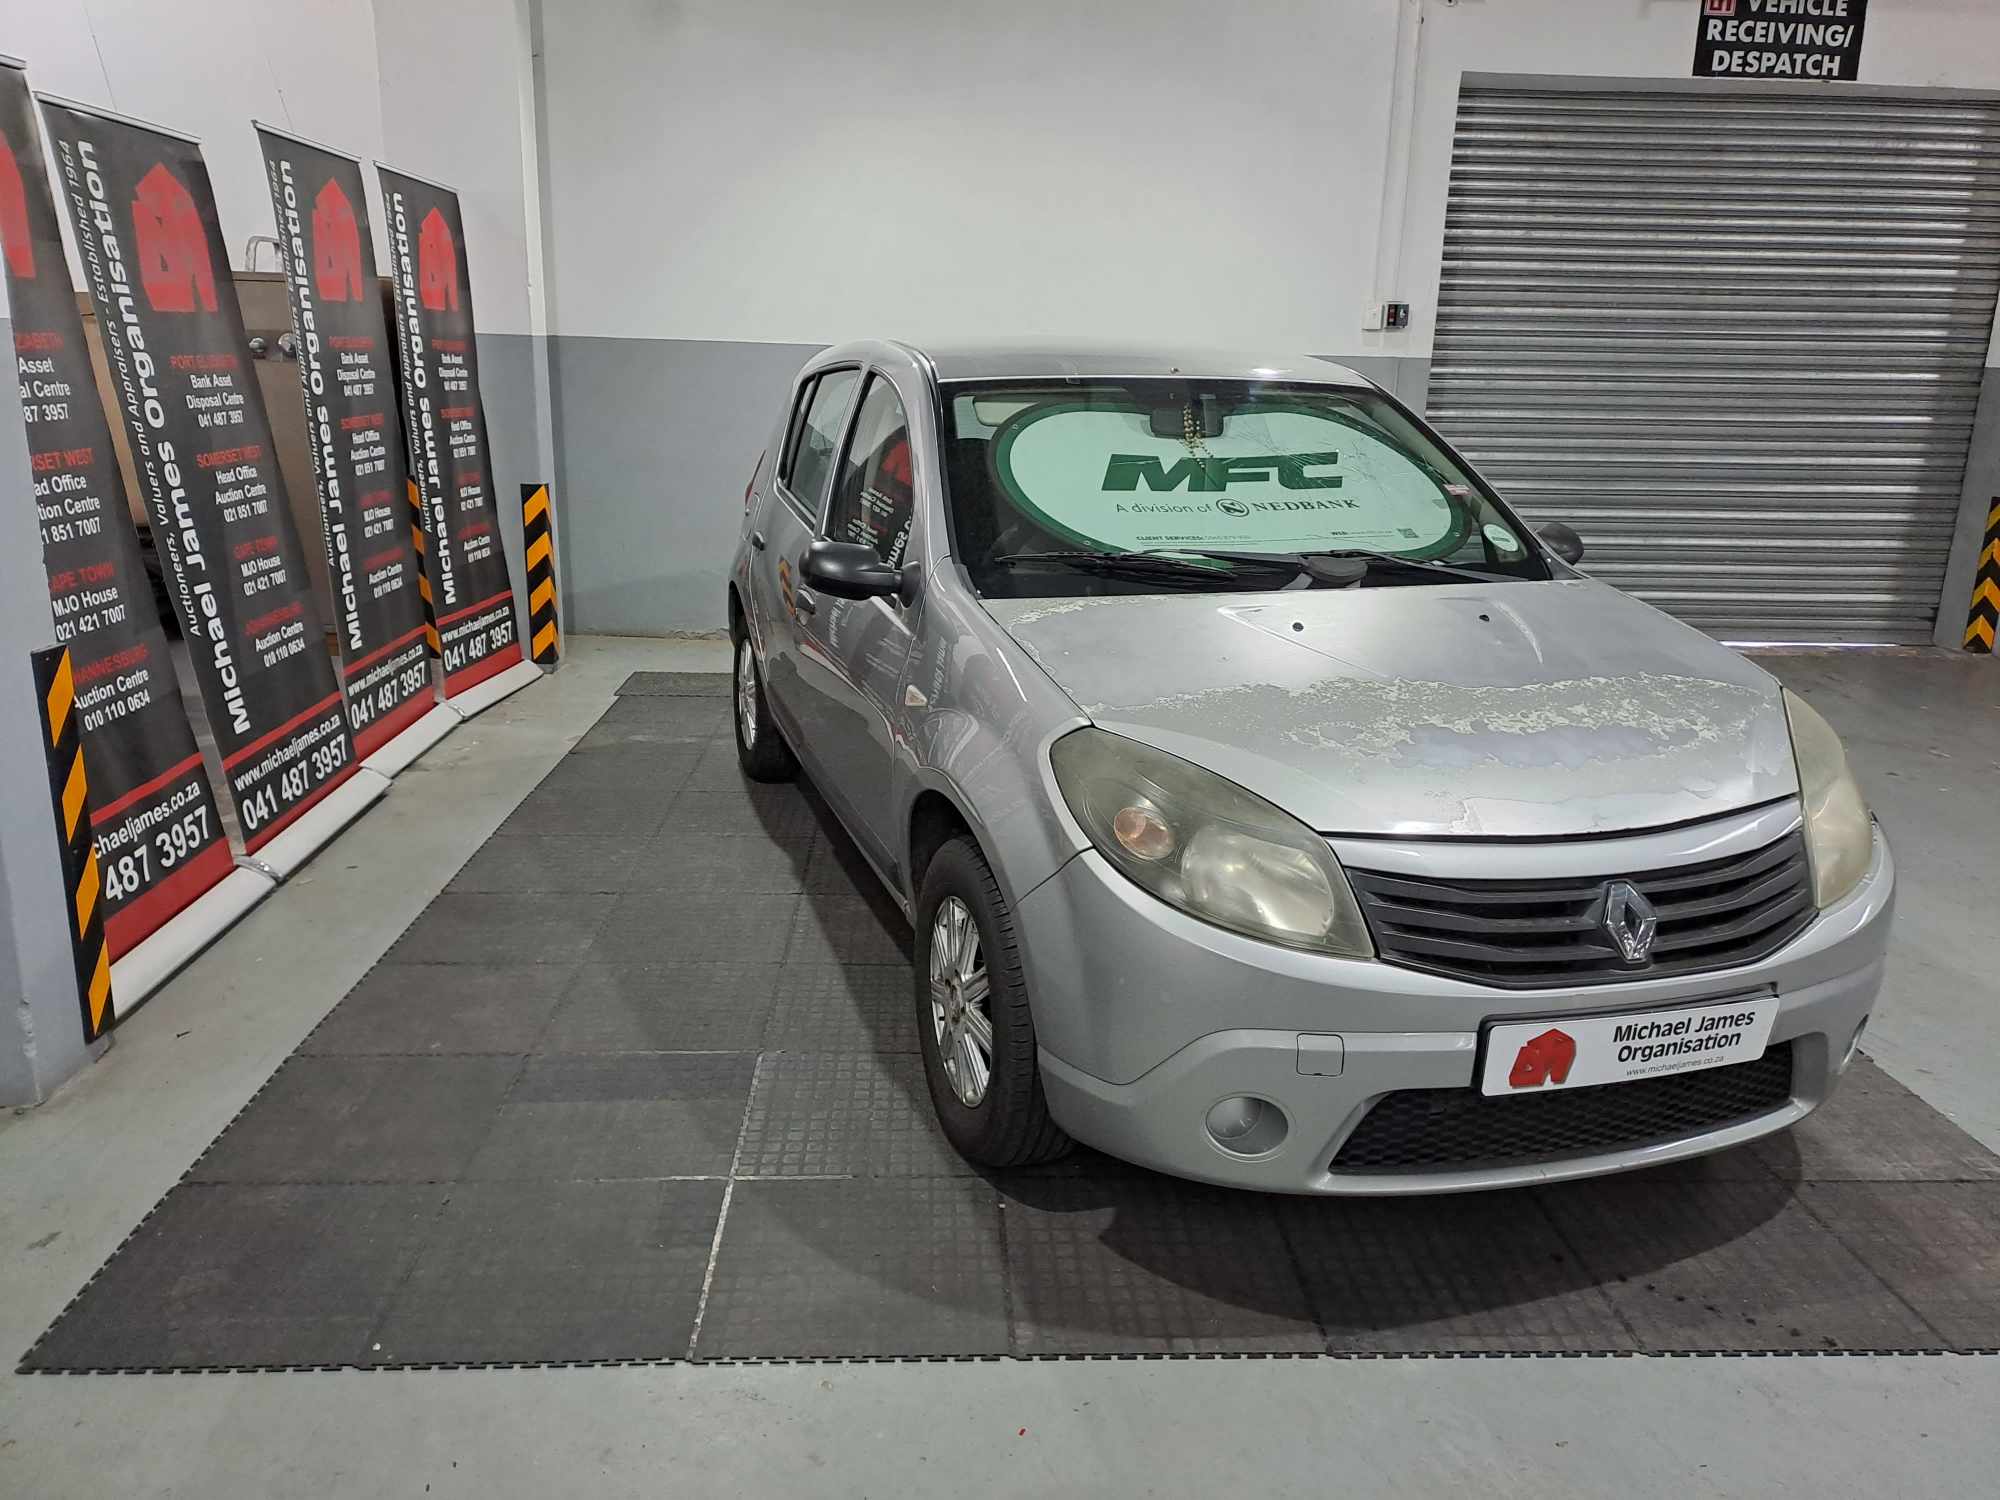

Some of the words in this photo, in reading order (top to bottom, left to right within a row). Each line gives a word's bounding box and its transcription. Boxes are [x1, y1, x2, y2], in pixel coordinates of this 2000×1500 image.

[1750, 0, 1848, 17] VEHICLE
[1706, 19, 1855, 48] RECEIVING/
[1711, 50, 1841, 77] DESPATCH
[58, 139, 81, 188] 1964
[71, 193, 110, 304] Established
[77, 140, 166, 429] Organisation
[279, 160, 325, 395] Organisation
[392, 192, 426, 389] Organisation
[19, 357, 54, 373] Asset
[106, 319, 142, 417] Appraisers
[190, 374, 213, 389] Bank
[33, 380, 71, 397] Centre
[185, 395, 221, 411] Disposal
[222, 392, 245, 405] Centre
[42, 403, 69, 421] 3957
[198, 414, 212, 428] 041
[213, 411, 227, 426] 487
[228, 410, 244, 423] 3957
[131, 420, 151, 456] and
[420, 397, 441, 490] James
[215, 468, 235, 485] Head
[236, 465, 258, 480] Office
[316, 405, 343, 515] James
[1101, 451, 1343, 492] MFC
[51, 475, 87, 493] Office
[145, 461, 170, 526] Valuers
[215, 487, 245, 505] Auction
[244, 484, 267, 498] Centre
[64, 497, 101, 515] Centre
[157, 440, 206, 571] James
[223, 507, 238, 523] 021
[238, 503, 252, 519] 851
[251, 500, 268, 515] 7007
[1116, 503, 1129, 513] A
[1131, 503, 1194, 513] division
[1199, 501, 1214, 512] of
[1255, 499, 1361, 512] NEDBANK
[51, 523, 75, 542] 851
[75, 517, 101, 537] 7007
[430, 496, 457, 605] Michael
[53, 594, 80, 617] MJO
[81, 587, 118, 608] House
[165, 532, 202, 637] Auctioneers,
[332, 523, 363, 650] Michael
[56, 621, 77, 641] 021
[79, 613, 100, 633] 421
[101, 605, 126, 626] 7007
[441, 606, 510, 643] www.michaeljames.co.za
[193, 581, 251, 735] Michael
[444, 642, 466, 672] 041
[468, 632, 487, 660] 487
[489, 620, 513, 649] 3957
[116, 669, 149, 692] Centre
[347, 643, 424, 697] www.michaeljames.co.za
[84, 710, 105, 732] 010
[105, 701, 126, 721] 110
[127, 689, 151, 712] 0634
[351, 693, 375, 730] 041
[378, 678, 398, 711] 487
[400, 660, 425, 697] 3957
[234, 714, 341, 791] www.michaeljames.co.za
[242, 783, 278, 830] 041
[281, 759, 309, 801] 487
[311, 733, 348, 780] 3957
[105, 844, 151, 900] 487
[155, 805, 209, 868] 3957
[1613, 1017, 1691, 1043] Michael
[1694, 1011, 1756, 1033] James
[1617, 1032, 1741, 1063] Organisation
[1626, 1056, 1724, 1077] www.michaeljames.co.za
